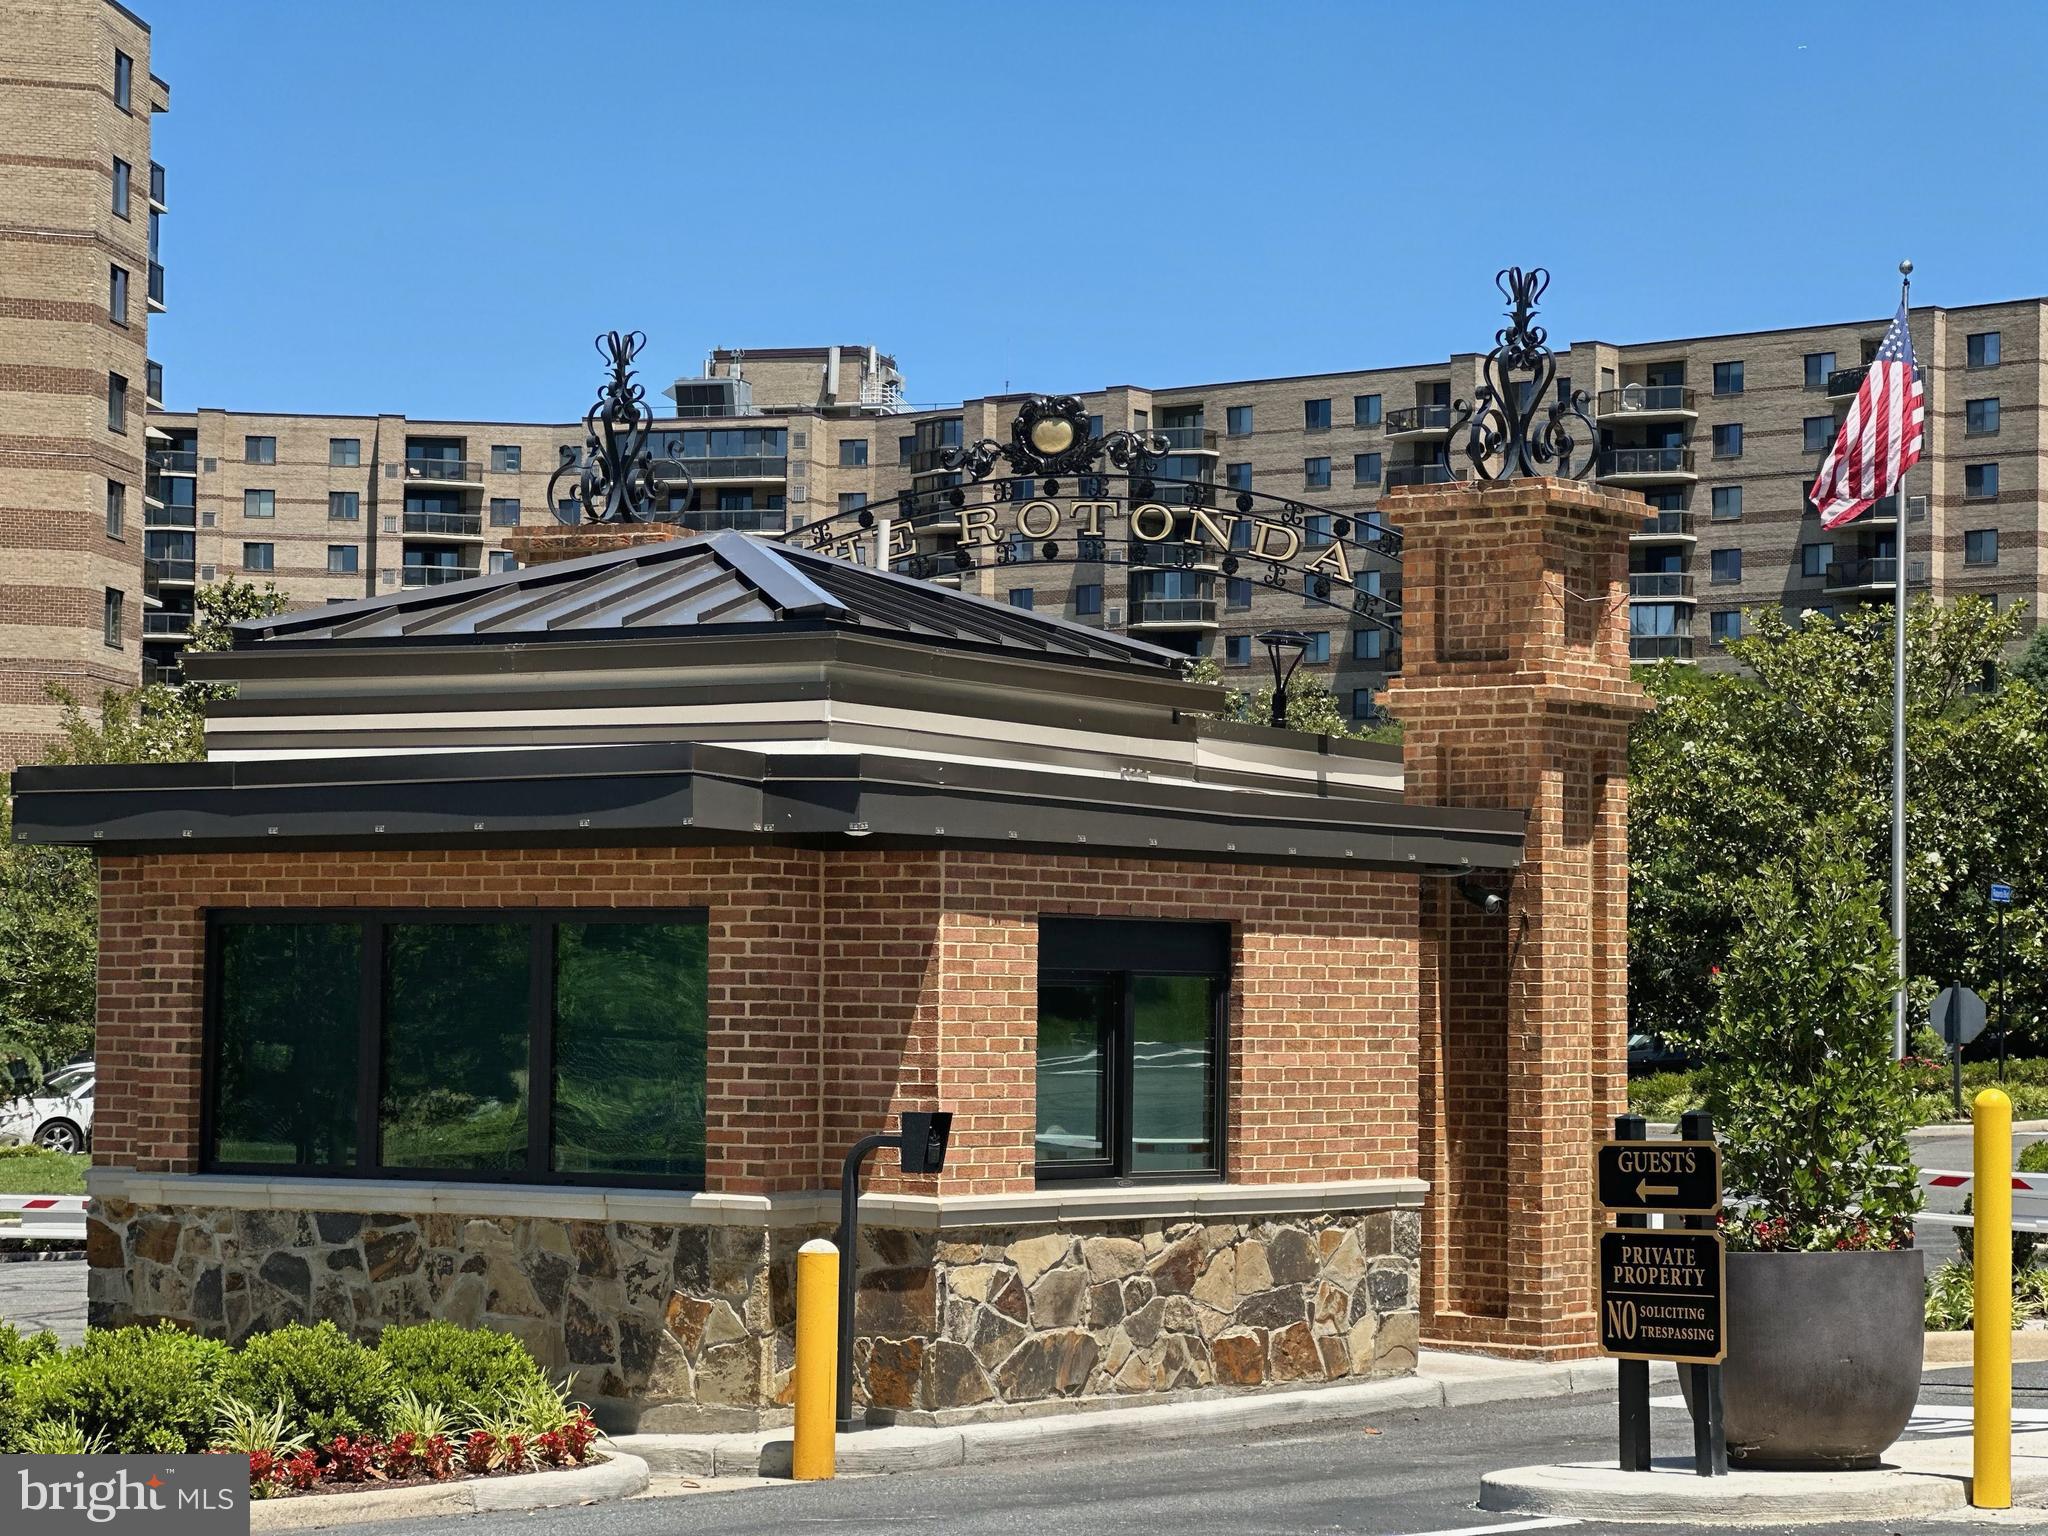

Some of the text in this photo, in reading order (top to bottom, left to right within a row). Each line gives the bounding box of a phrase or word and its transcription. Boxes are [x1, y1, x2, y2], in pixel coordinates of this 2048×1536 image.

[813, 499, 1354, 583] HE ROTONDA
[1618, 1151, 1697, 1173] GUESTS
[1621, 1246, 1696, 1266] PRIVATE
[1613, 1266, 1706, 1287] PROPERTY
[1607, 1300, 1705, 1340] NO SOLICITING
[1640, 1325, 1715, 1341] TRESPASSING
